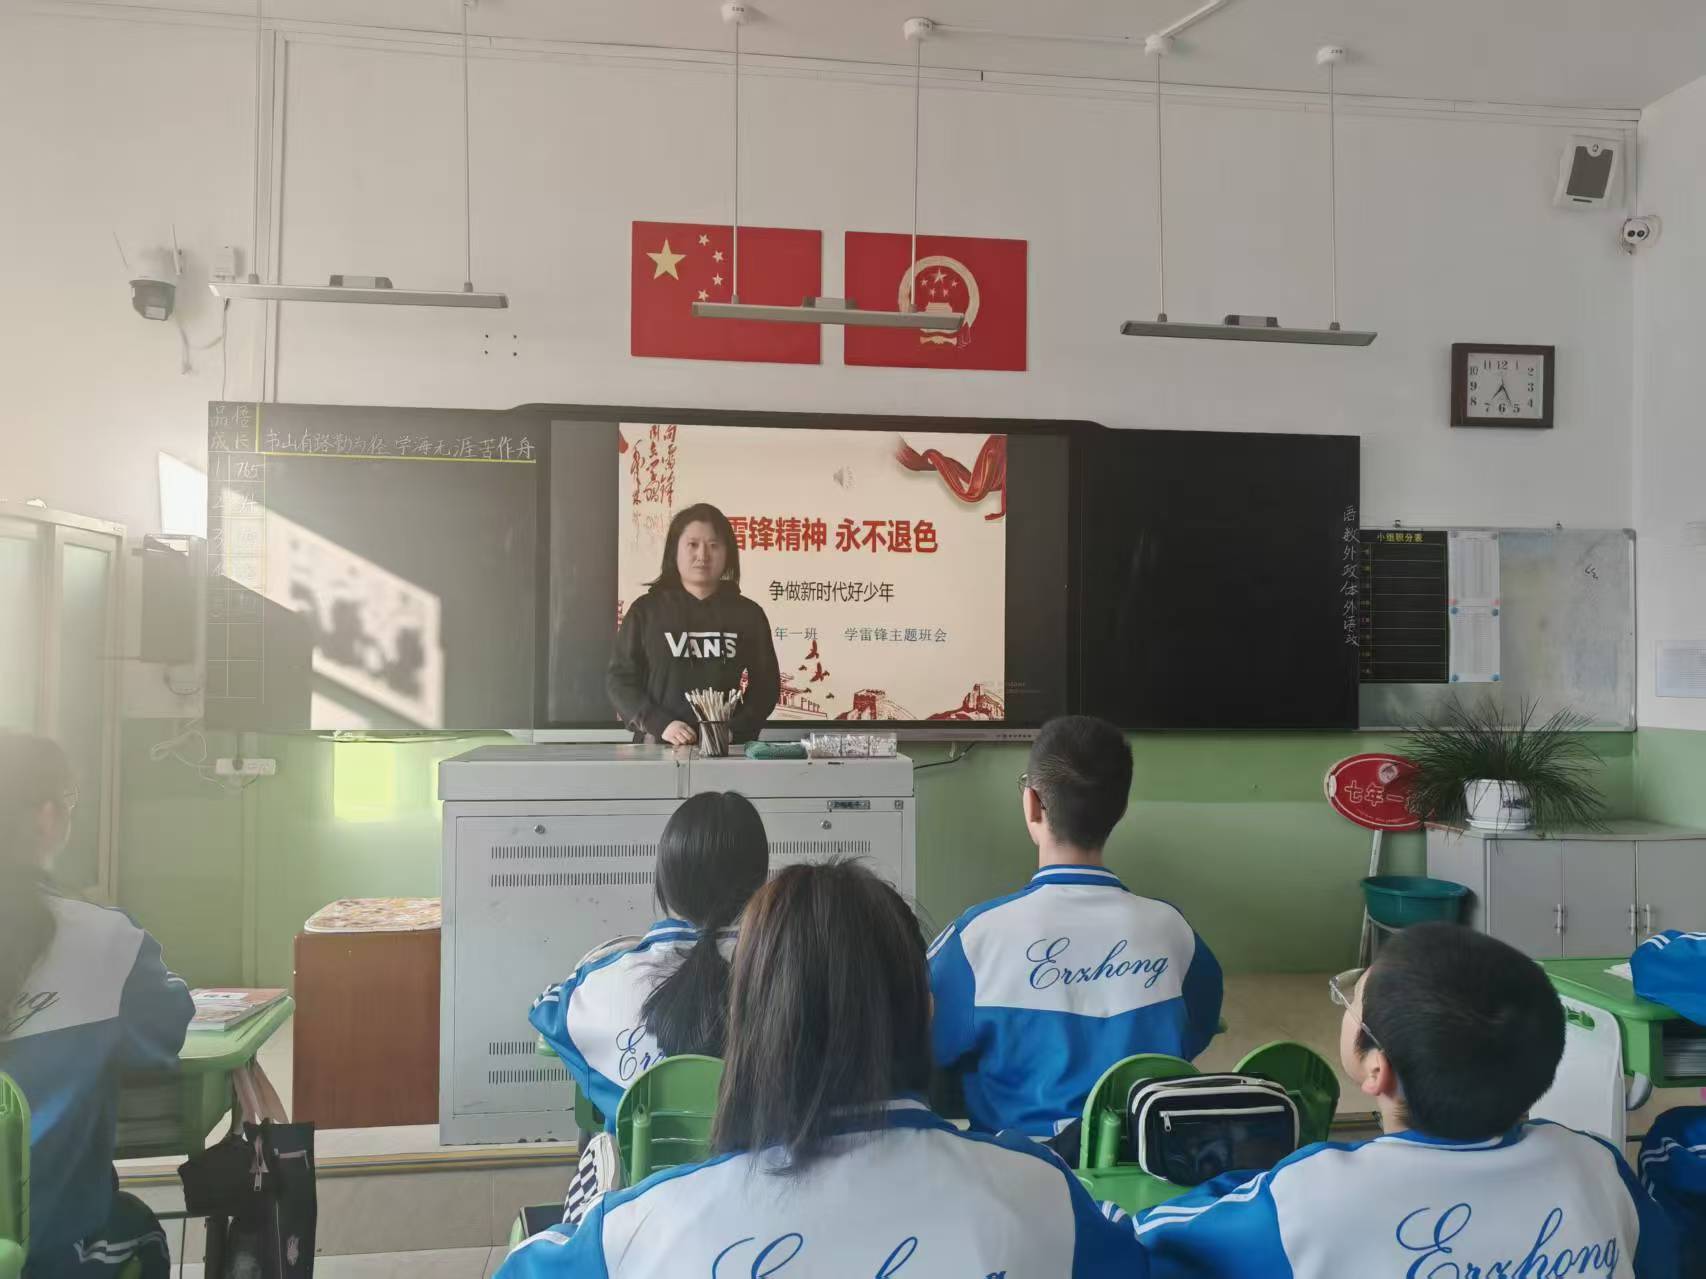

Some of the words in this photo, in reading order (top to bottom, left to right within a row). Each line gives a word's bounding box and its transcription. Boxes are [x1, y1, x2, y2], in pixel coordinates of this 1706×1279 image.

[835, 518, 938, 553] 永不退色
[769, 580, 895, 603] 争做新时代好少年
[664, 631, 738, 658] VANS
[775, 627, 818, 641] 年一班
[844, 627, 947, 643] 学雷锋主题班会
[1026, 937, 1168, 989] Erzhong
